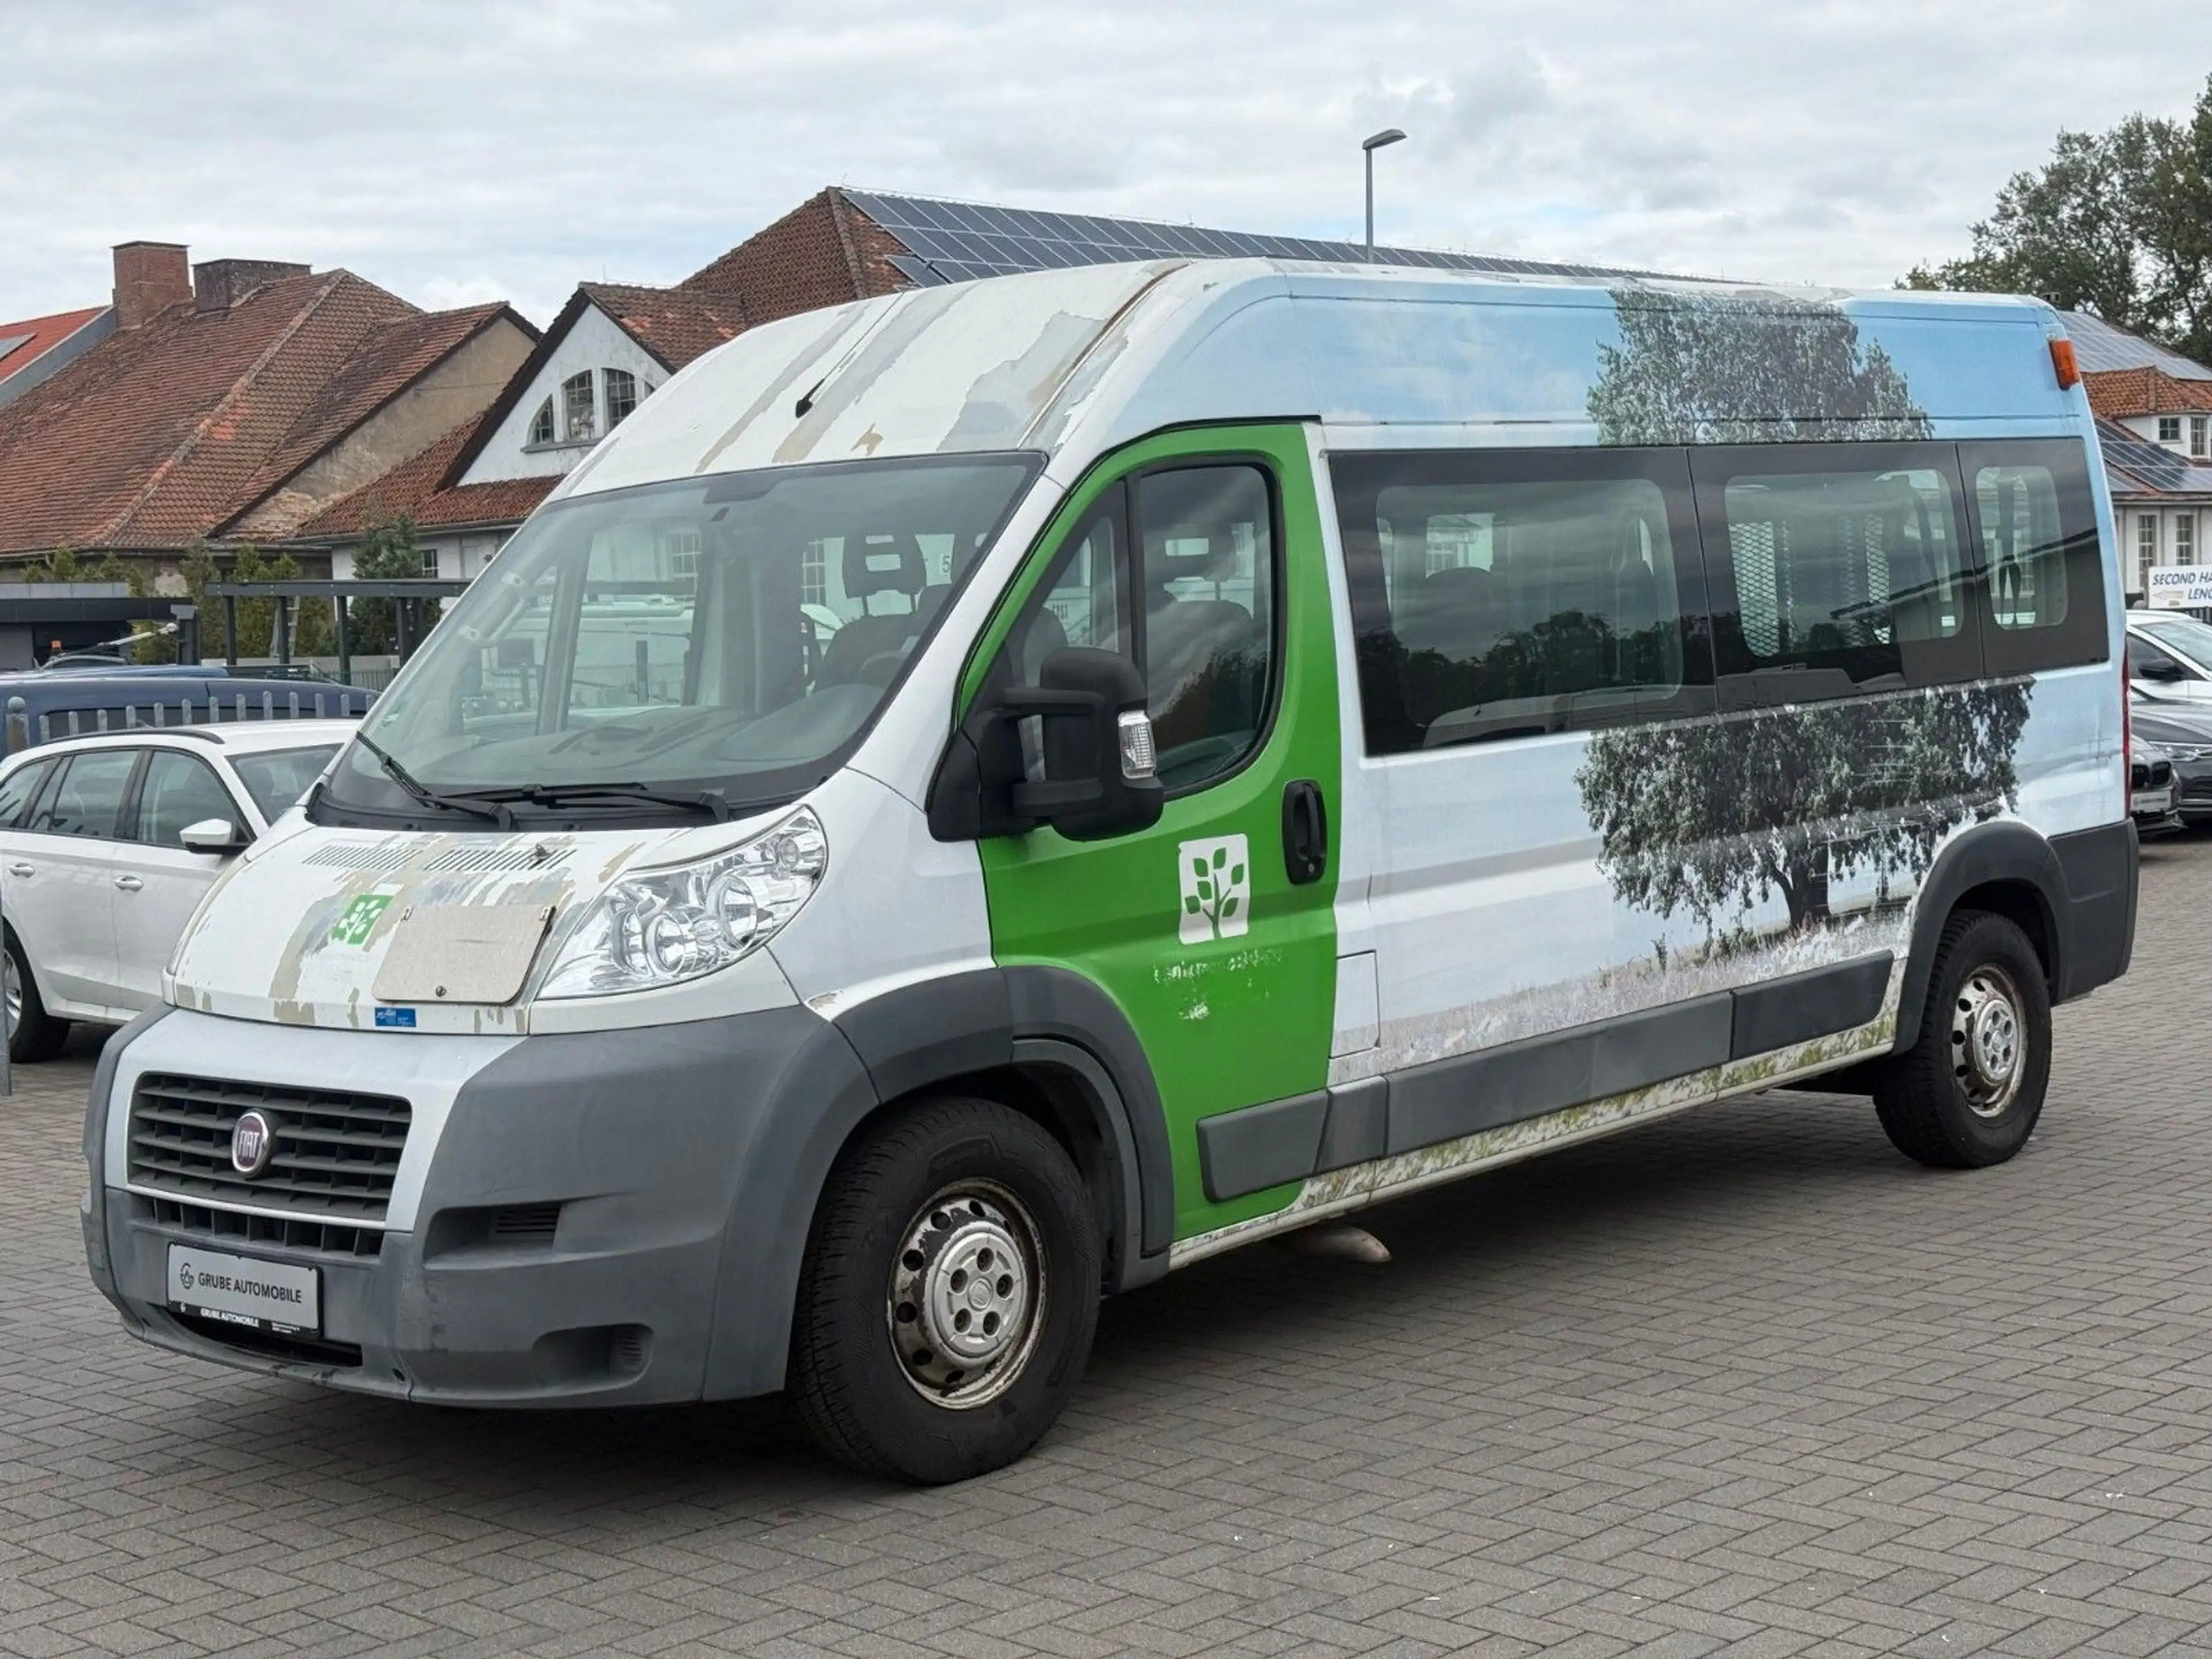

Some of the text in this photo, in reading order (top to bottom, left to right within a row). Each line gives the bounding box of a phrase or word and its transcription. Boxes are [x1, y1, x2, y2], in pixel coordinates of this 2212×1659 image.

[2153, 572, 2196, 585] SECOND
[238, 1130, 260, 1159] FIAT
[198, 1272, 302, 1304] GRUBE AUTOMOBILE
